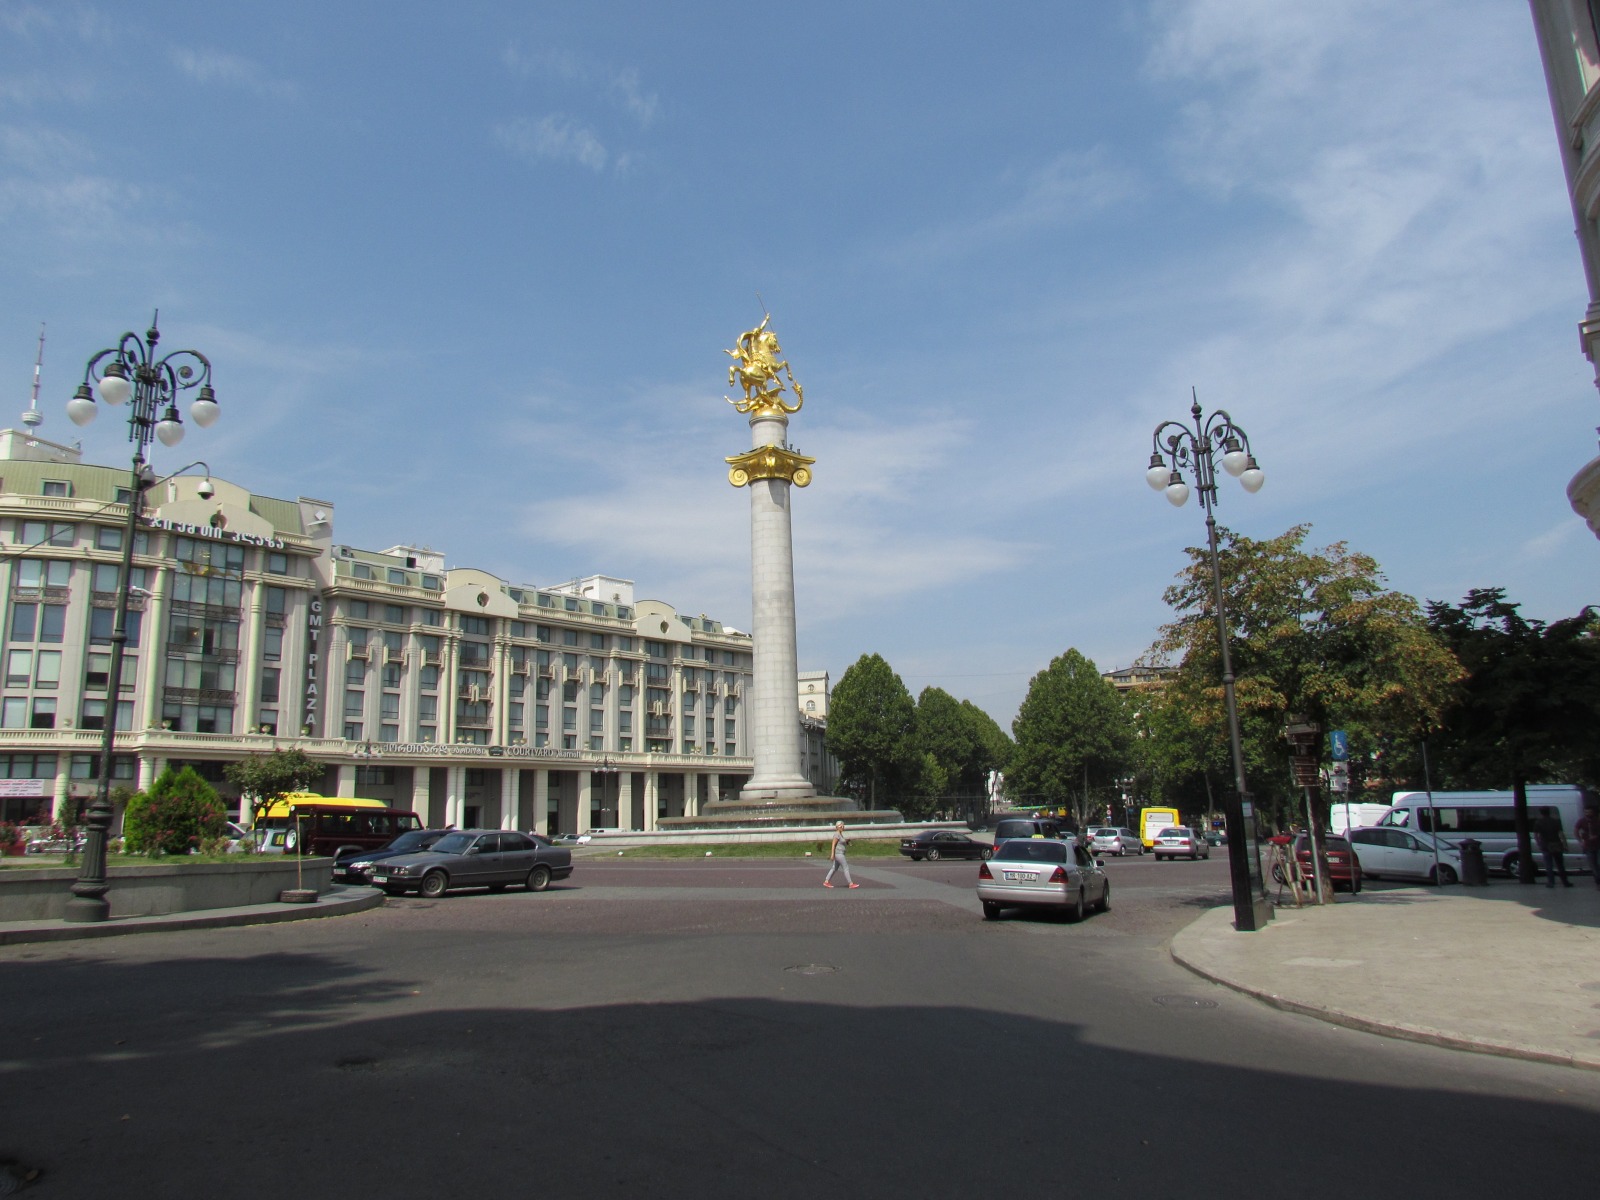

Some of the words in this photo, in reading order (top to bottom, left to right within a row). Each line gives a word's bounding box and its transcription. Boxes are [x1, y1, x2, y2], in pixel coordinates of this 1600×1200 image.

[149, 516, 173, 531] ჯი
[200, 525, 223, 540] თი
[309, 600, 323, 641] GMT
[305, 653, 319, 725] PLAZA
[506, 746, 554, 758] COURTYARD
